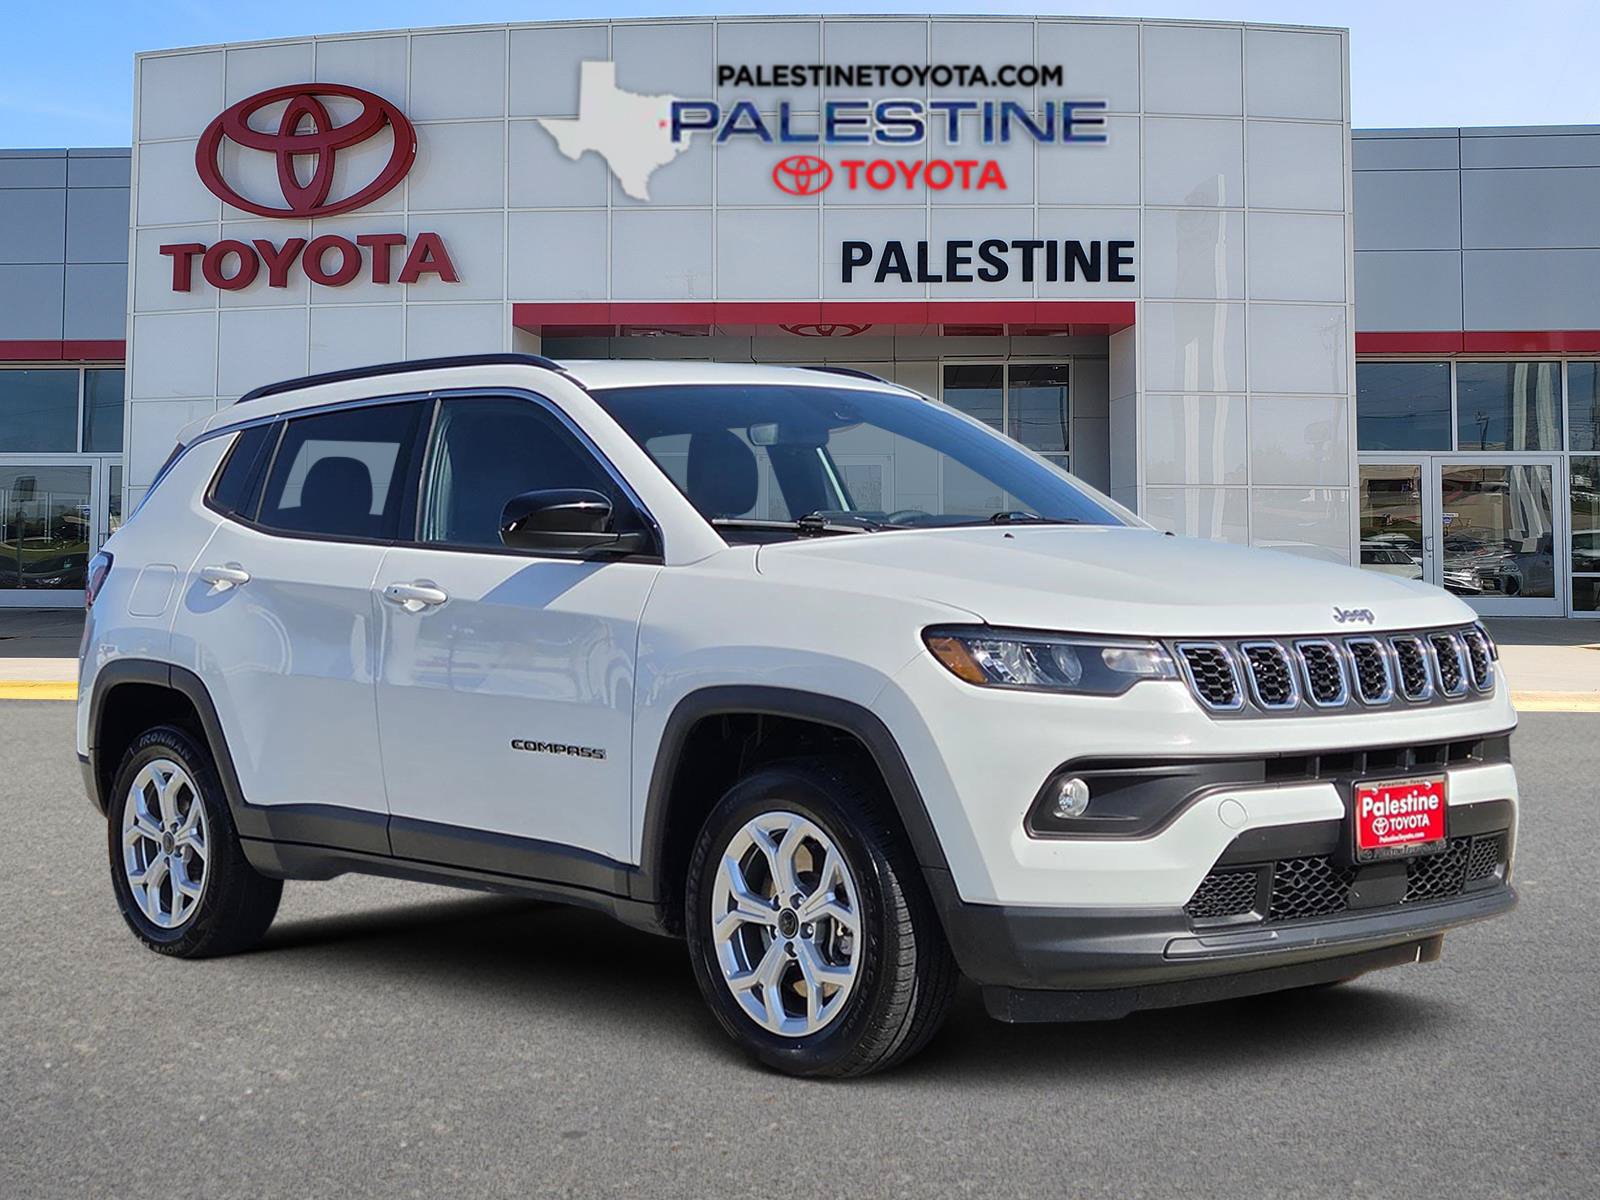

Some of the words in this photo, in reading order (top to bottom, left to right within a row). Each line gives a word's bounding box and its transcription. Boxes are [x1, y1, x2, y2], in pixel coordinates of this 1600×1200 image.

[159, 232, 461, 292] TOYOTA
[841, 239, 1137, 284] PALESTINE
[1333, 606, 1375, 625] Jeep
[511, 739, 606, 760] COMPASS
[1362, 790, 1439, 818] Palestine
[1389, 813, 1430, 831] TOYOTA
